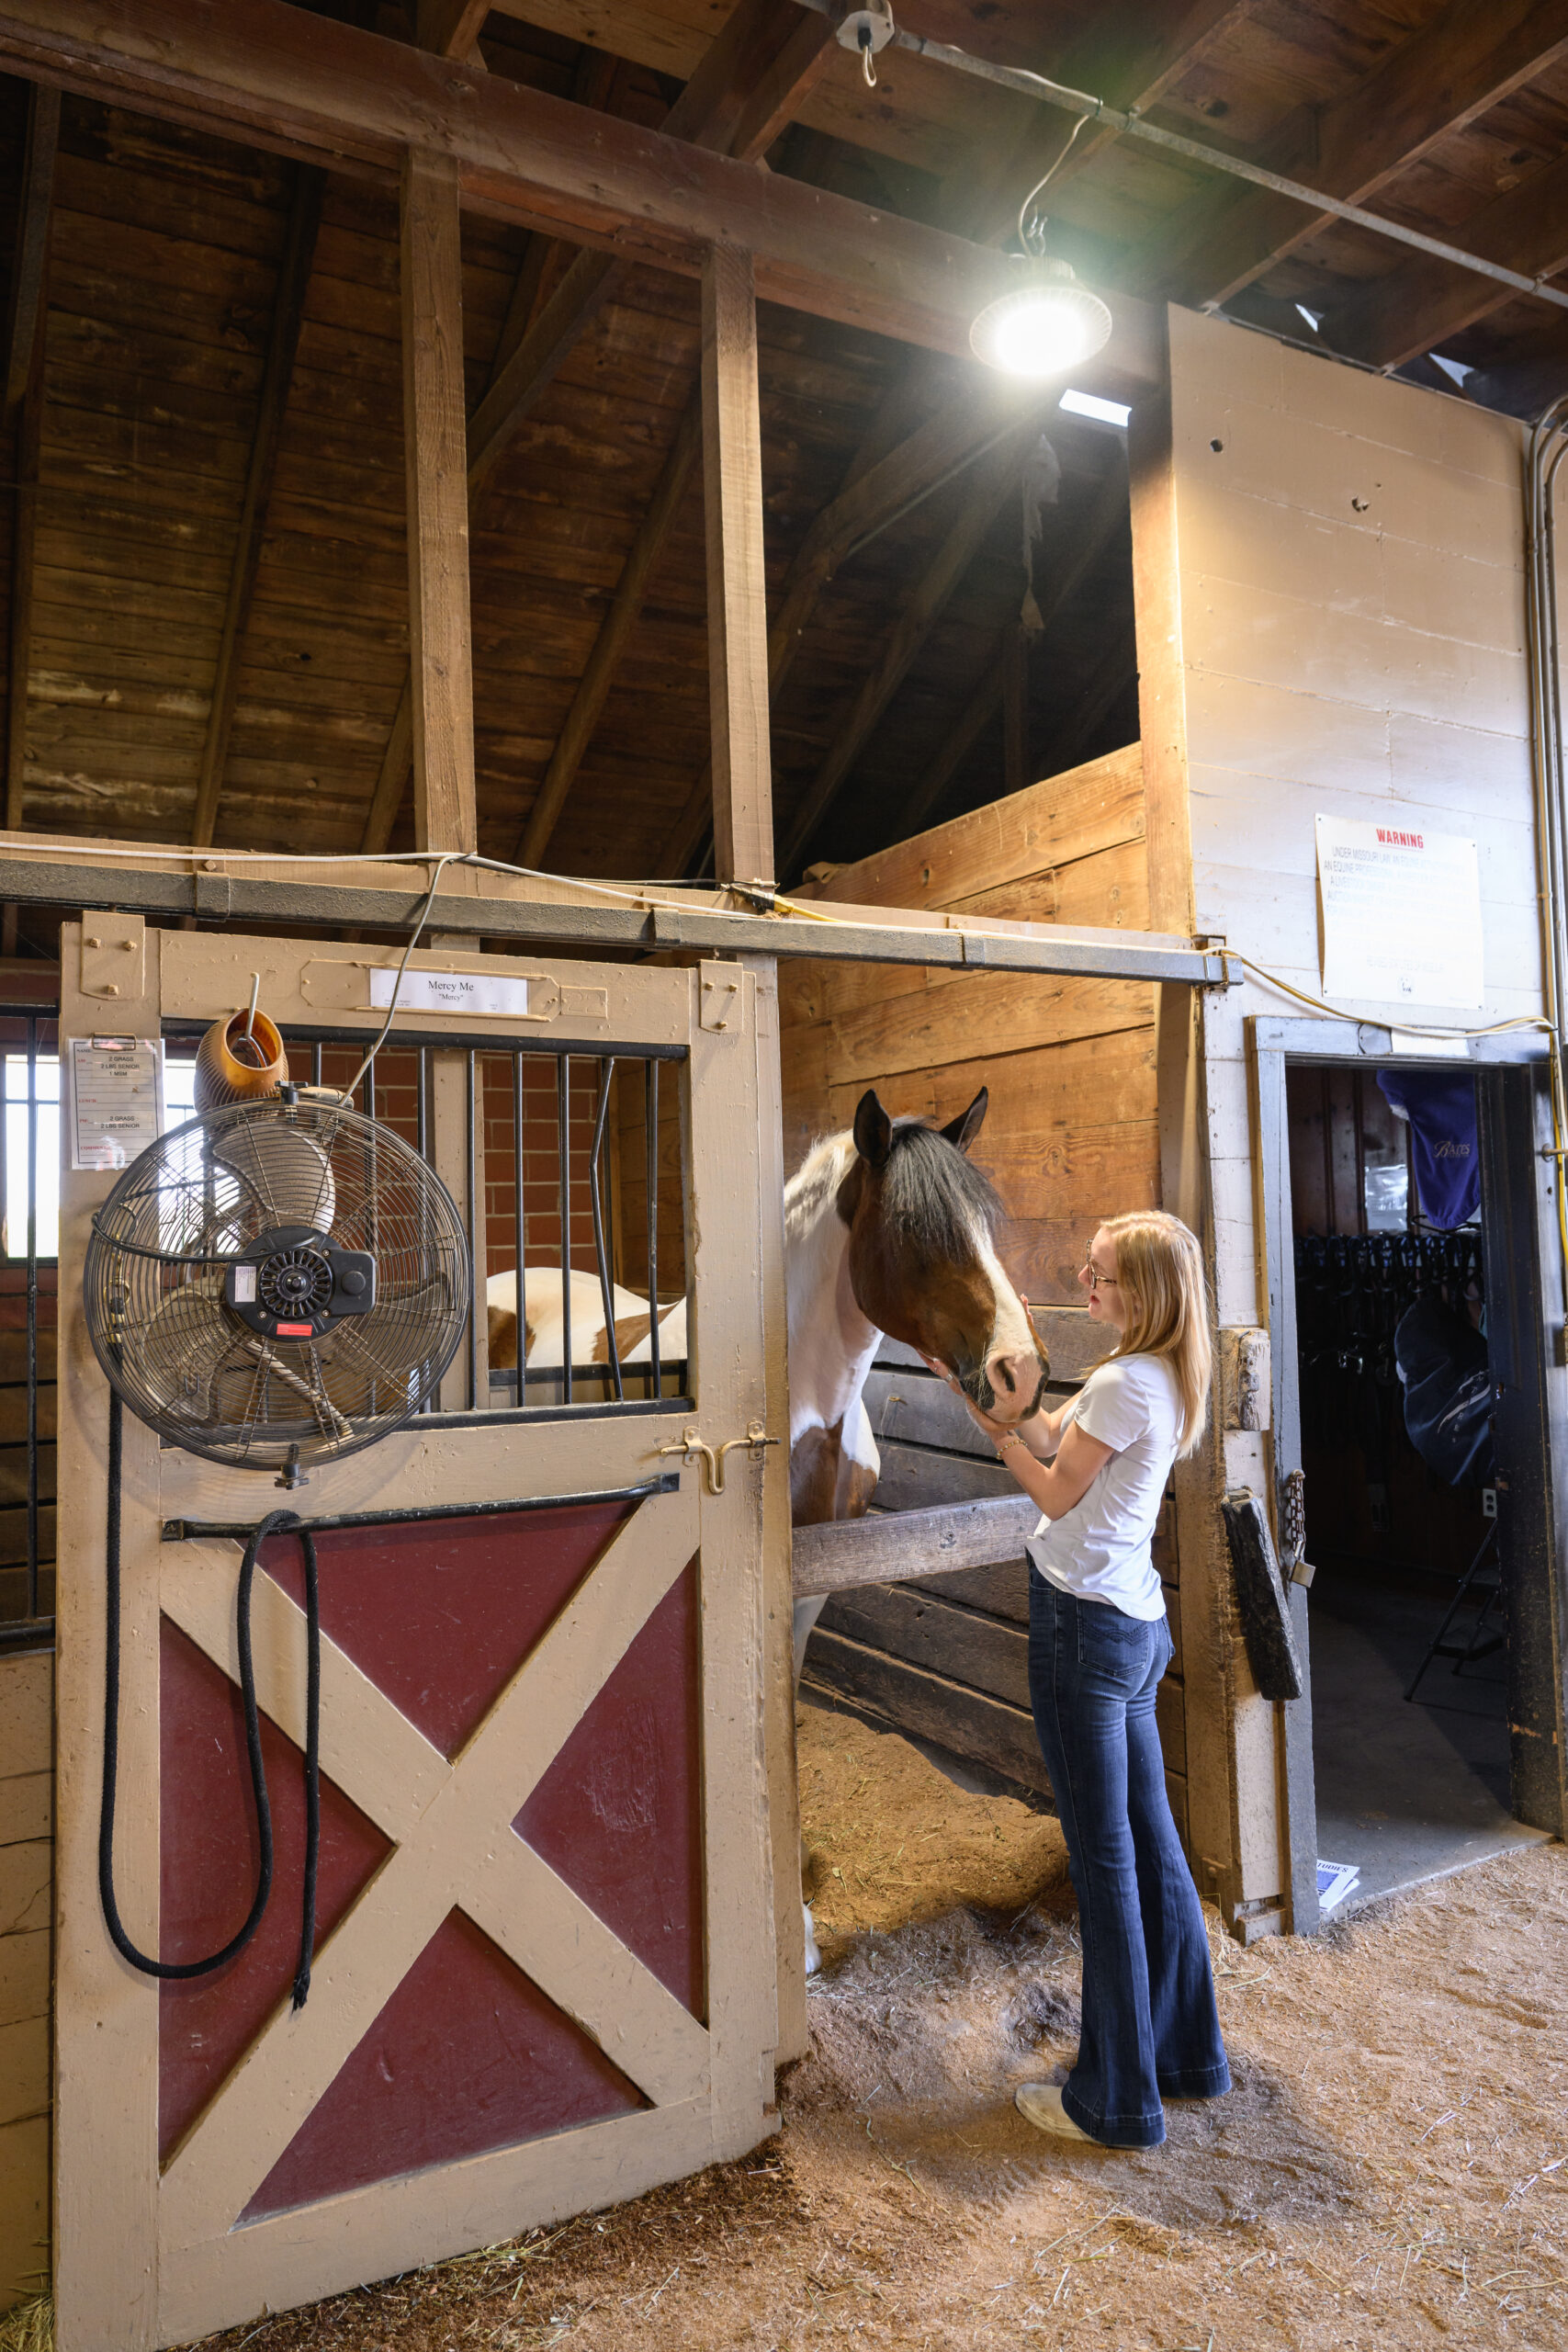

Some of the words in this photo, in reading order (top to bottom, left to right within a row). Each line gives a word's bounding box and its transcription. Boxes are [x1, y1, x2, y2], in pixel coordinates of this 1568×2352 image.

[1376, 828, 1424, 849] WARNING
[1333, 846, 1351, 858] UNDER
[1352, 849, 1379, 863] MISSOURI
[1324, 860, 1332, 871] AN
[428, 979, 457, 992] Mercy
[459, 981, 474, 991] Me
[438, 993, 464, 1001] "Mercy"
[1433, 1140, 1471, 1159] BATES
[1317, 1862, 1348, 1872] TUDIES
